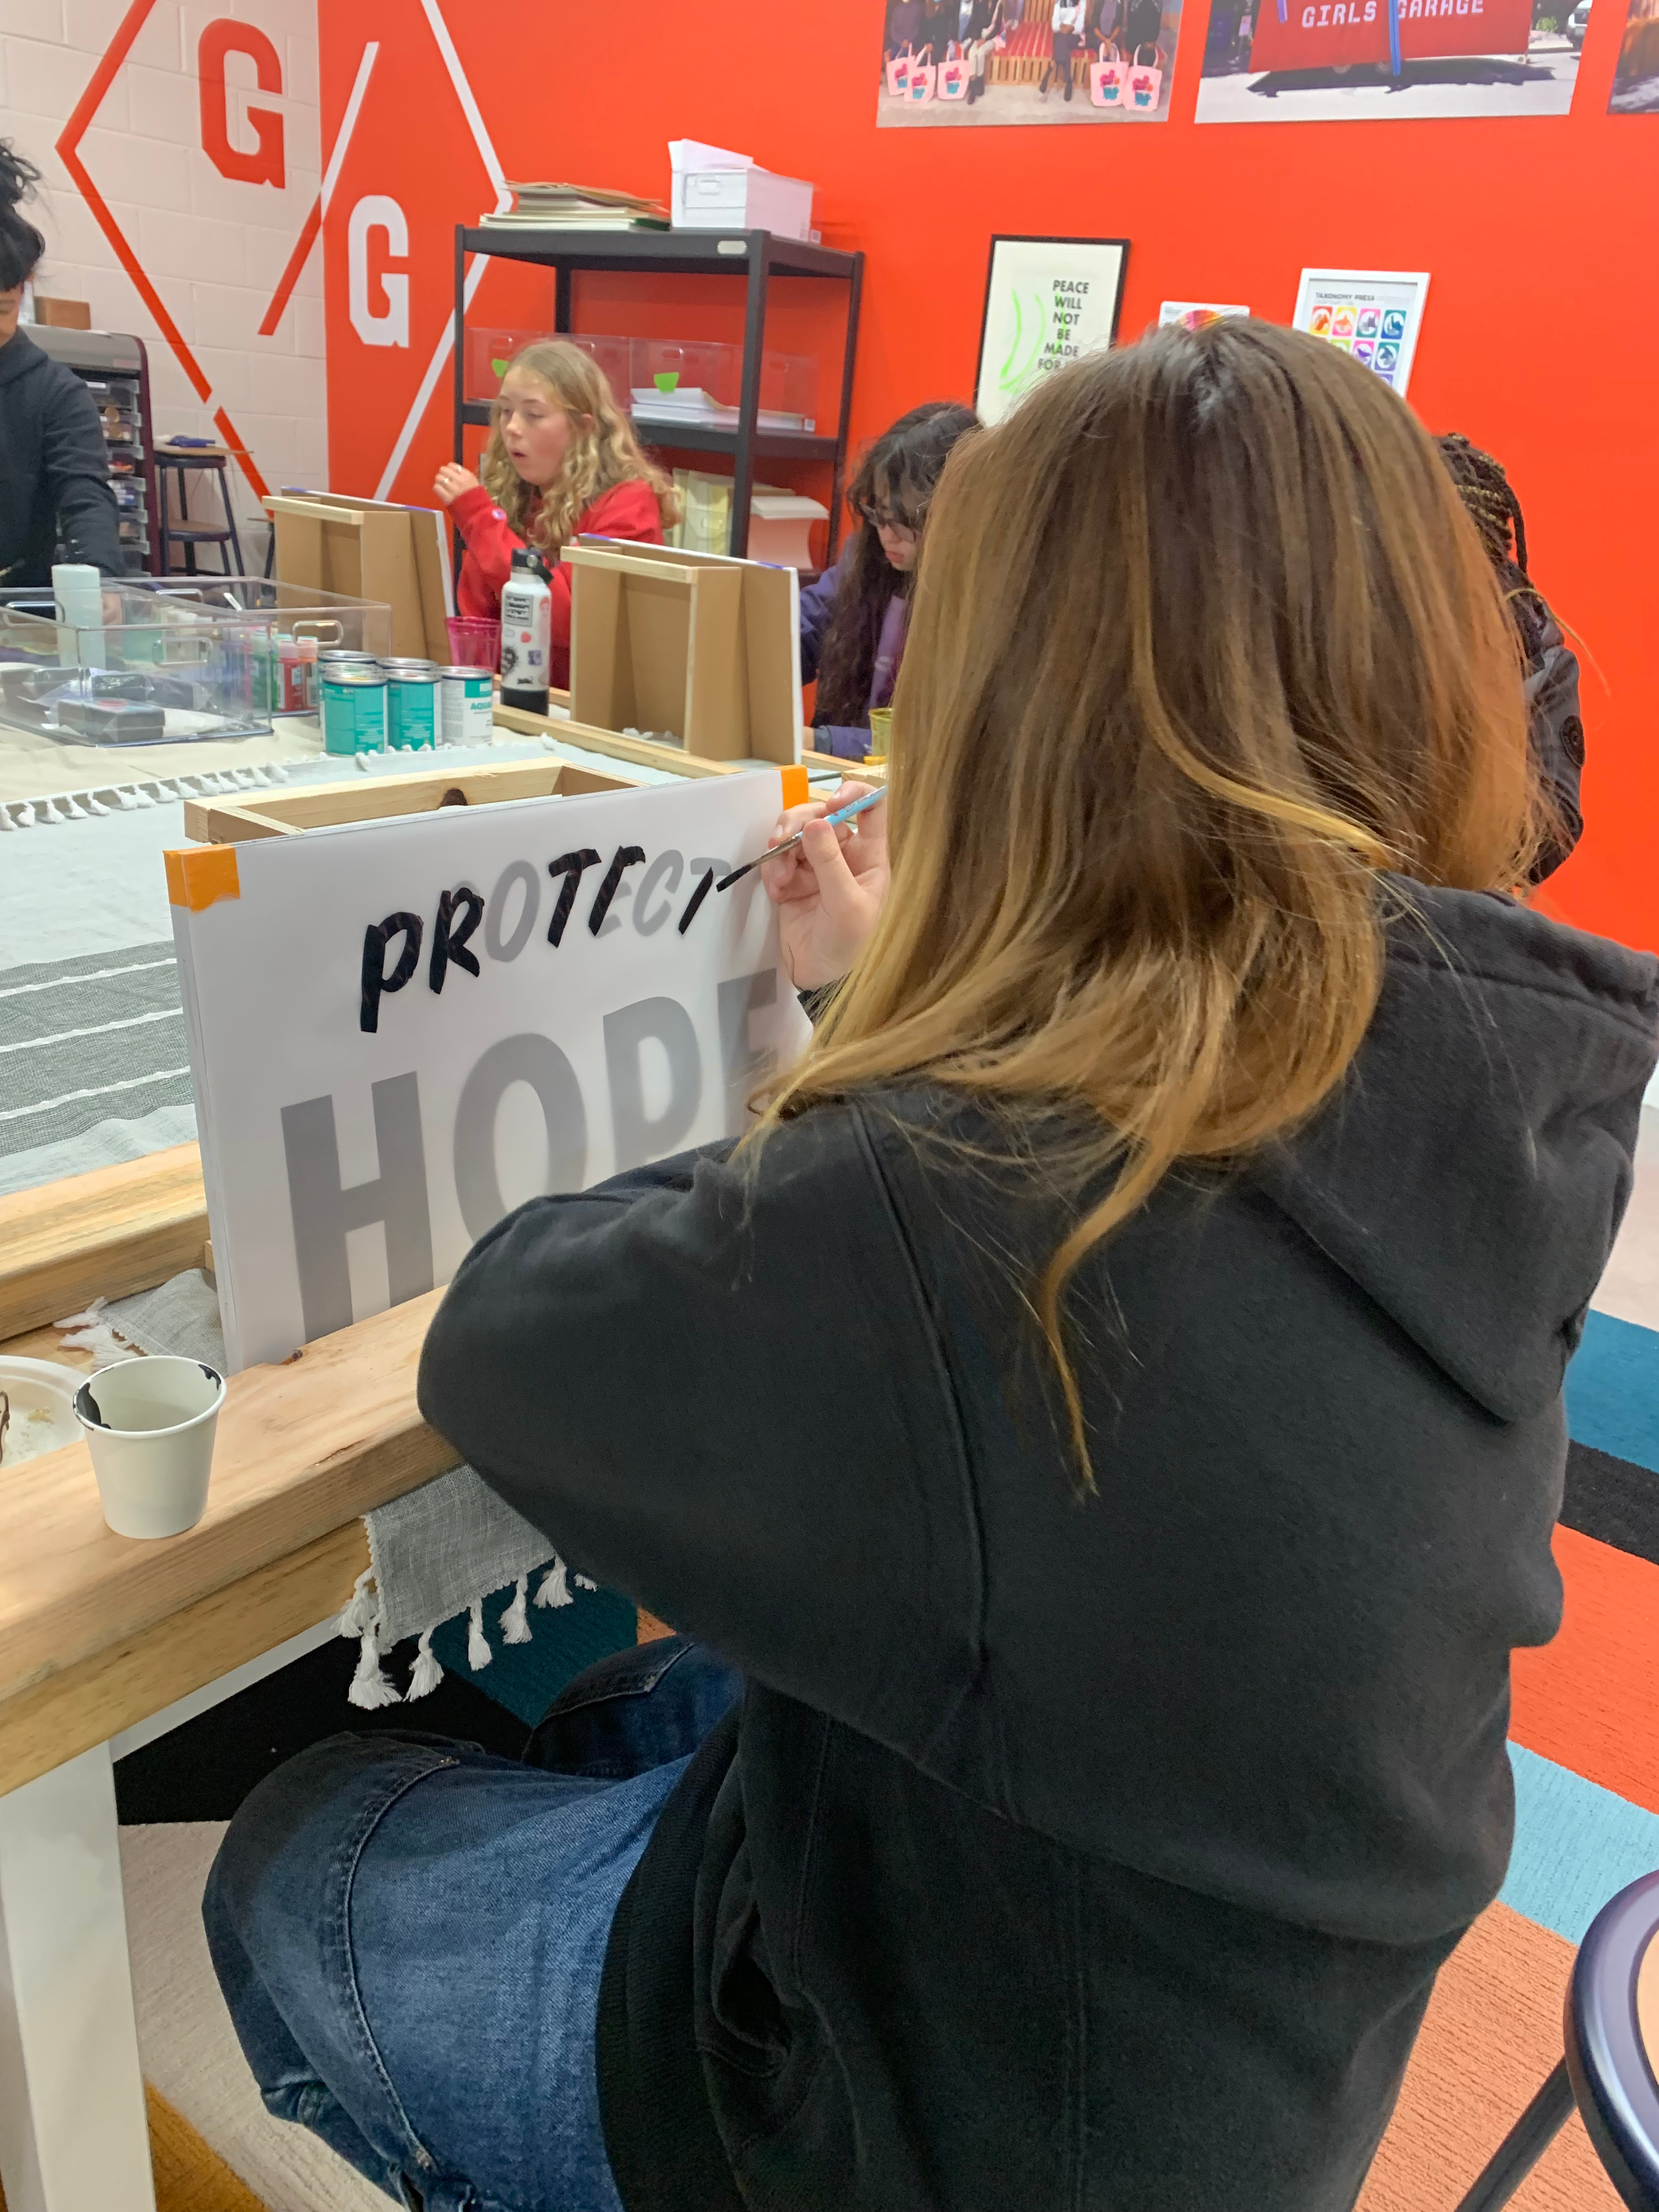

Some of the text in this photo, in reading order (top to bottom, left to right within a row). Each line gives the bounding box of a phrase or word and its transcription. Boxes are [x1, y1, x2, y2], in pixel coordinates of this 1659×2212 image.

[1302, 1, 1378, 27] GIRLS
[198, 18, 285, 189] G
[348, 194, 409, 348] G
[1052, 279, 1090, 295] PEACE
[1054, 295, 1082, 309] WILL
[1052, 311, 1081, 326] NOT
[1057, 328, 1071, 341] BE
[1043, 342, 1080, 357] MADE
